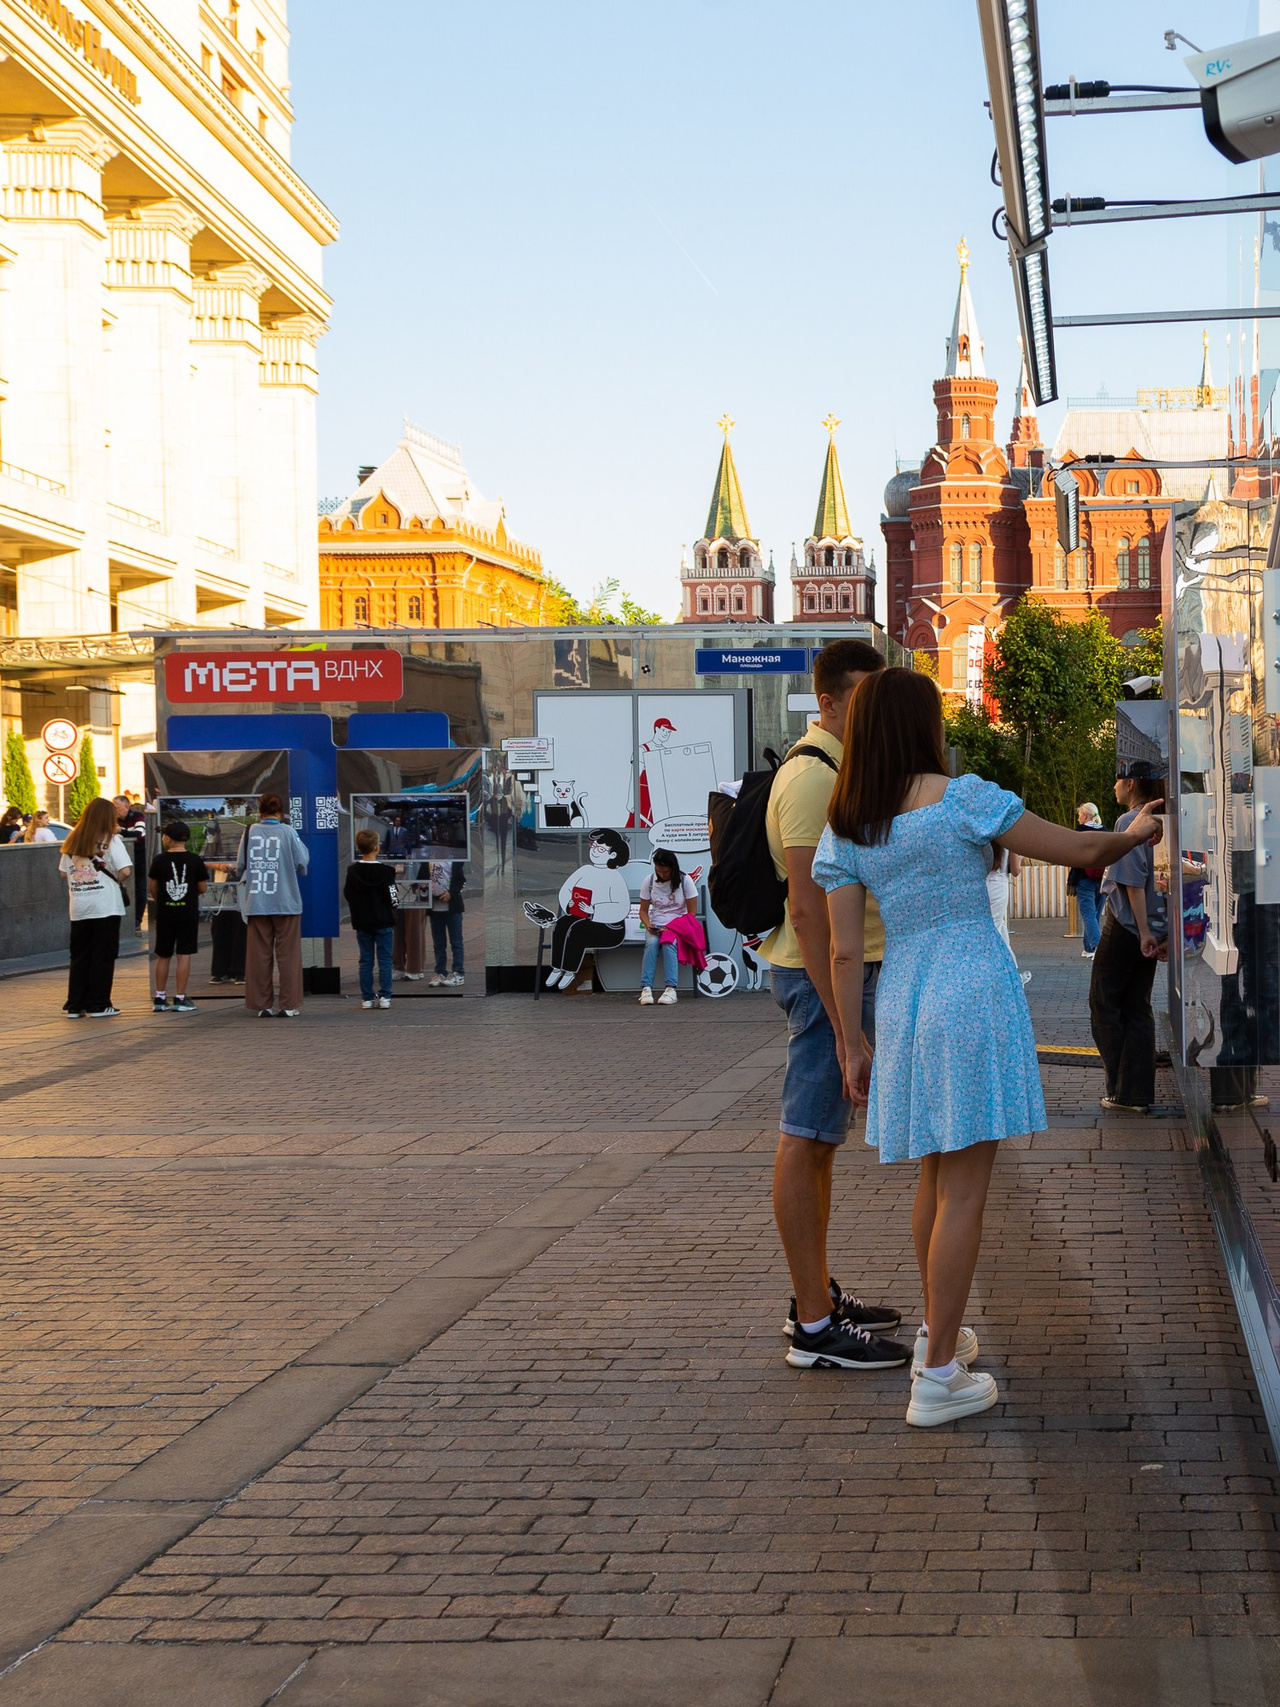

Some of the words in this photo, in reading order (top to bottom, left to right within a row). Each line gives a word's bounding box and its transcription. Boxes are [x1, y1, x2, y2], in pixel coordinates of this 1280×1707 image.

[1205, 58, 1233, 77] RVi
[721, 654, 781, 664] Манежная
[184, 661, 320, 692] МЕТА
[324, 660, 383, 682] ВДНХ
[250, 836, 280, 861] 20
[250, 861, 279, 870] МОСКВА
[249, 870, 278, 894] 30
